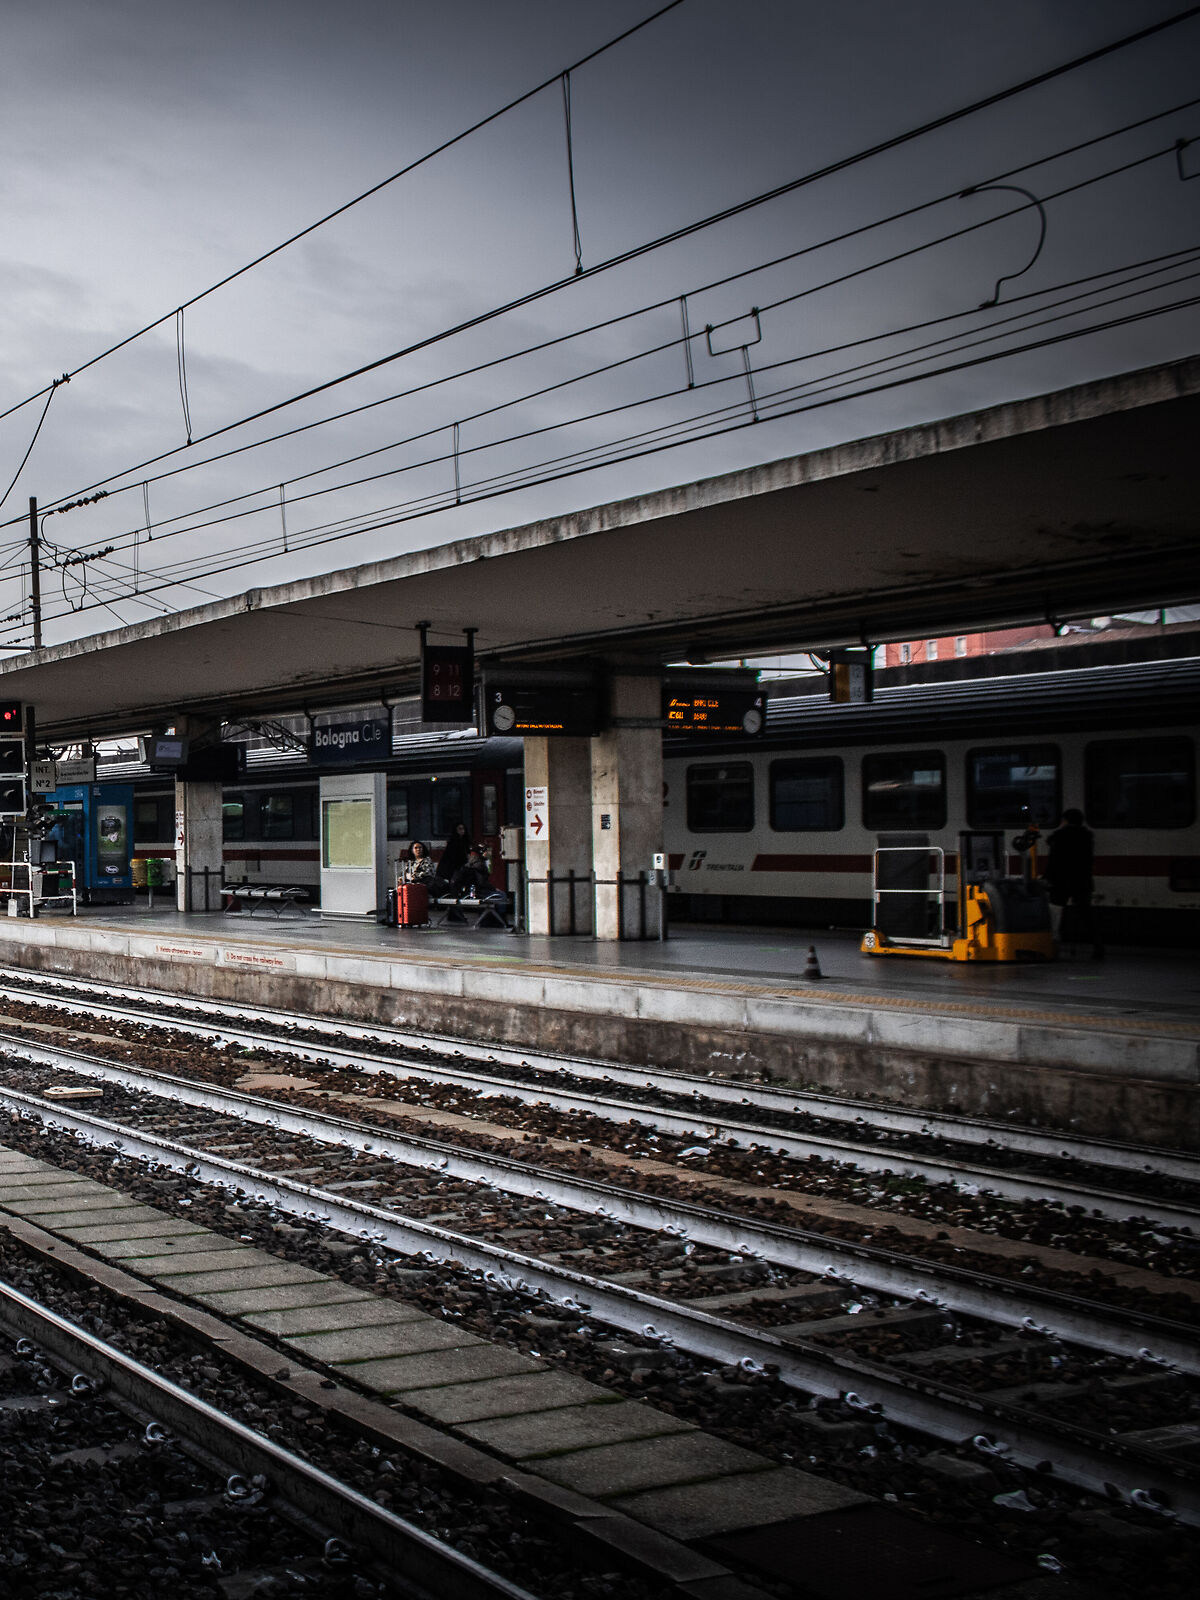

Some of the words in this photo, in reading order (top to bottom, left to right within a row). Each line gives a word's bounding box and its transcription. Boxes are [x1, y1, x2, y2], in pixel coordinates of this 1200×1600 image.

[433, 664, 441, 676] 9
[449, 685, 460, 697] 12
[495, 692, 502, 703] 3
[315, 728, 360, 749] Bologna
[362, 724, 381, 742] C.le
